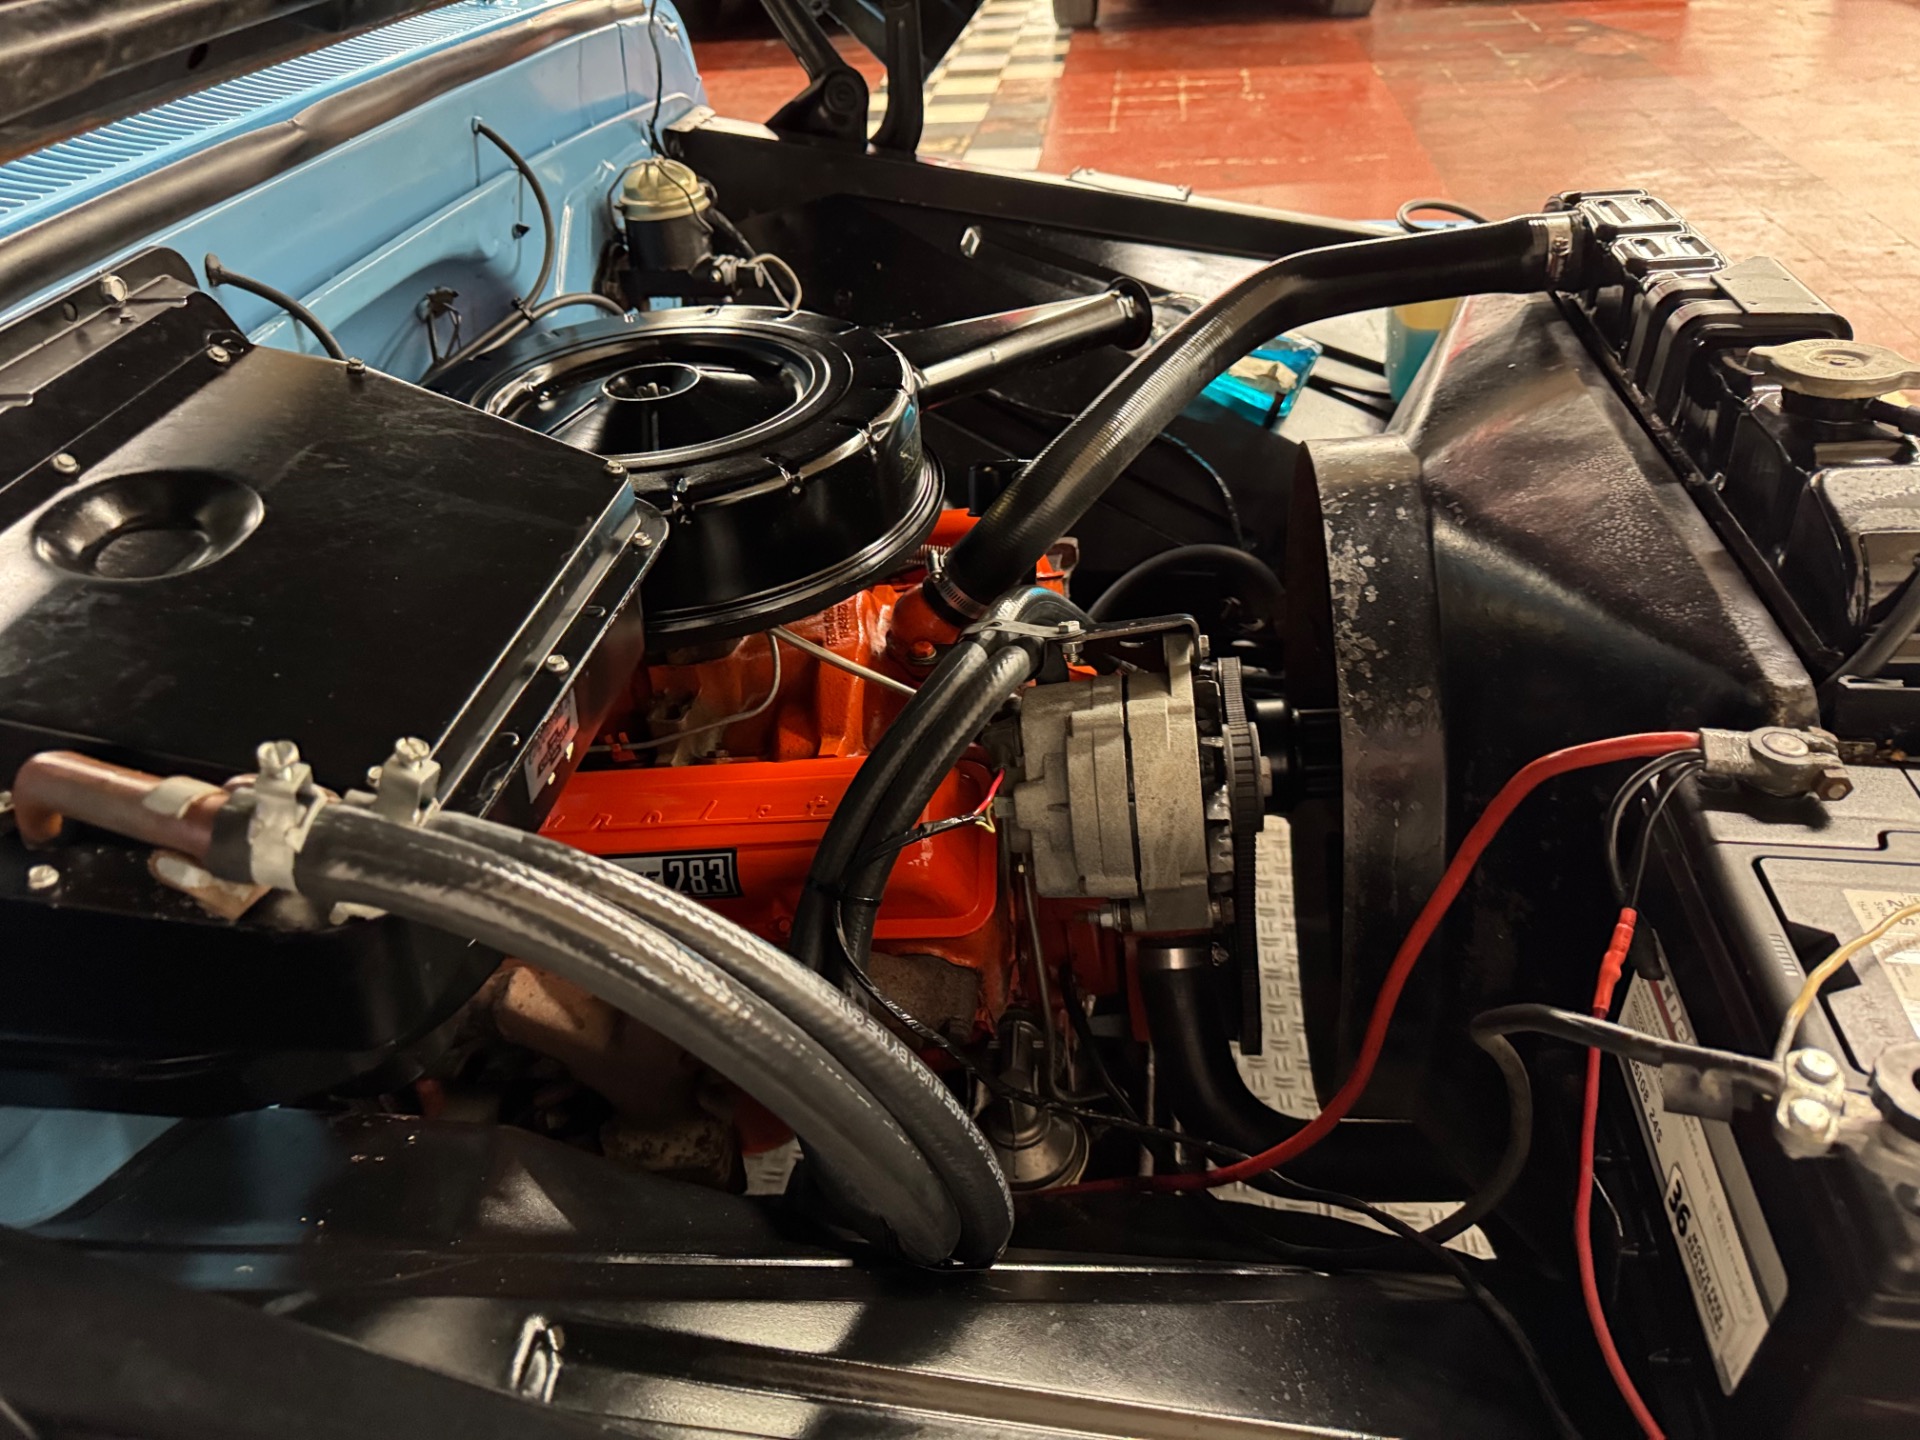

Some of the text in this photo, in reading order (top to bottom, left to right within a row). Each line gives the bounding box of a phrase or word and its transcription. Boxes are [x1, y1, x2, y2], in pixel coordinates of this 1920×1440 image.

[668, 858, 729, 894] 283
[866, 1018, 890, 1049] THE
[890, 1041, 909, 1065] BY
[1668, 1178, 1692, 1238] 36
